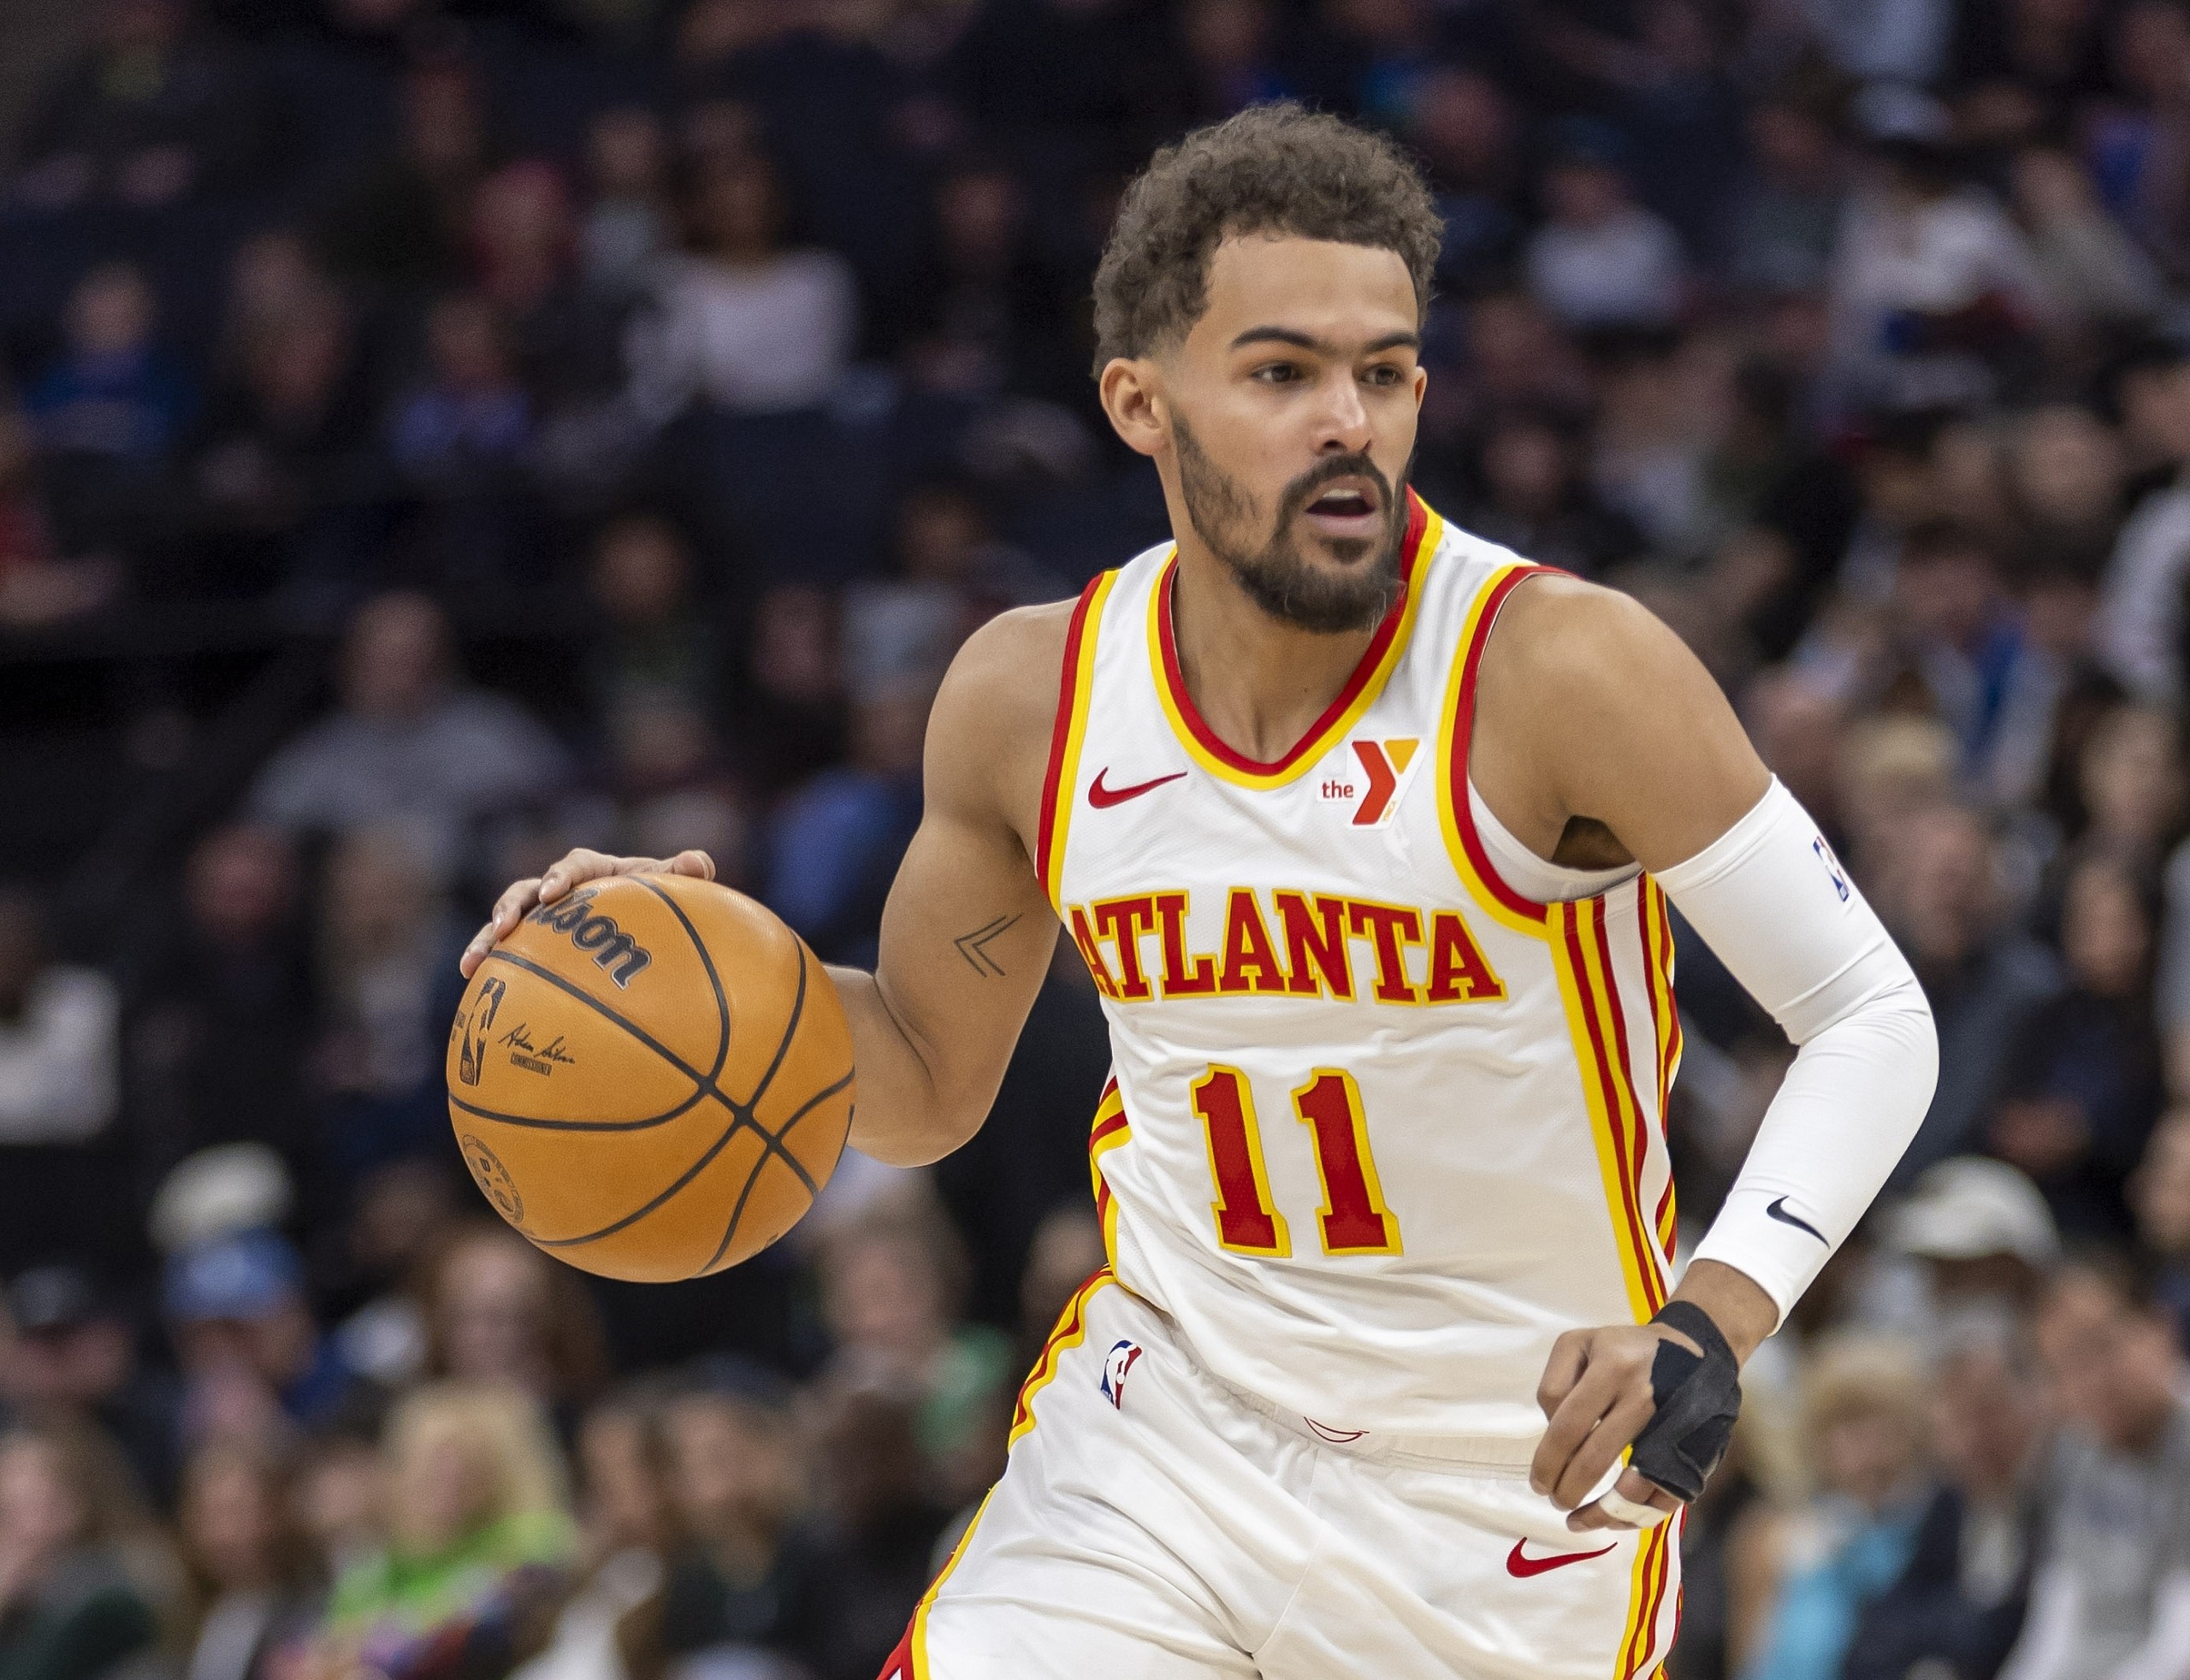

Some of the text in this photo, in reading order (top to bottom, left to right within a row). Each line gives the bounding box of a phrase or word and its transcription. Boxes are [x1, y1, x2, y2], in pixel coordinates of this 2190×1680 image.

[1322, 780, 1354, 798] the
[1068, 886, 1508, 1007] ATLANTA
[1190, 1062, 1404, 1258] 11
